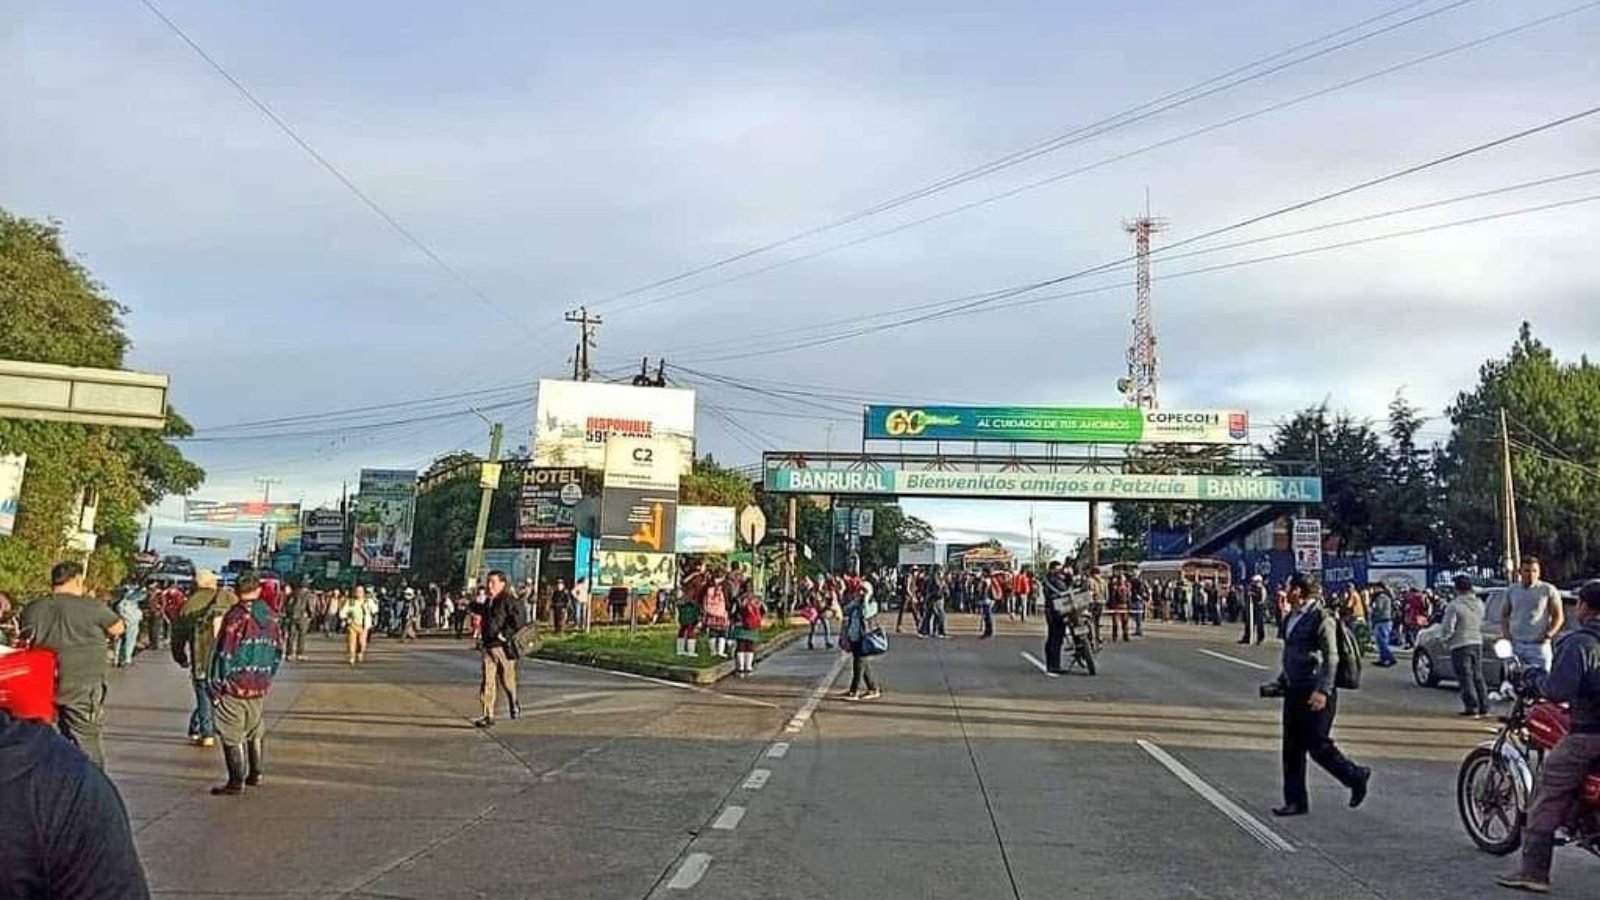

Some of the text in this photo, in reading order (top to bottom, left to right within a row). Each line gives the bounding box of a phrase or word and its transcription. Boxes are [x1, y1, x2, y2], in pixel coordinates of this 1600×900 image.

[587, 416, 652, 433] DISPONIBLE
[993, 419, 1041, 428] CUIDADO
[632, 447, 653, 462] C2
[524, 469, 580, 484] HOTEL
[789, 472, 887, 490] BANRURAL
[907, 474, 1016, 490] Bienvenidos
[1020, 478, 1088, 495] amigos
[1094, 481, 1105, 489] a
[1207, 479, 1312, 500] BANRURAL
